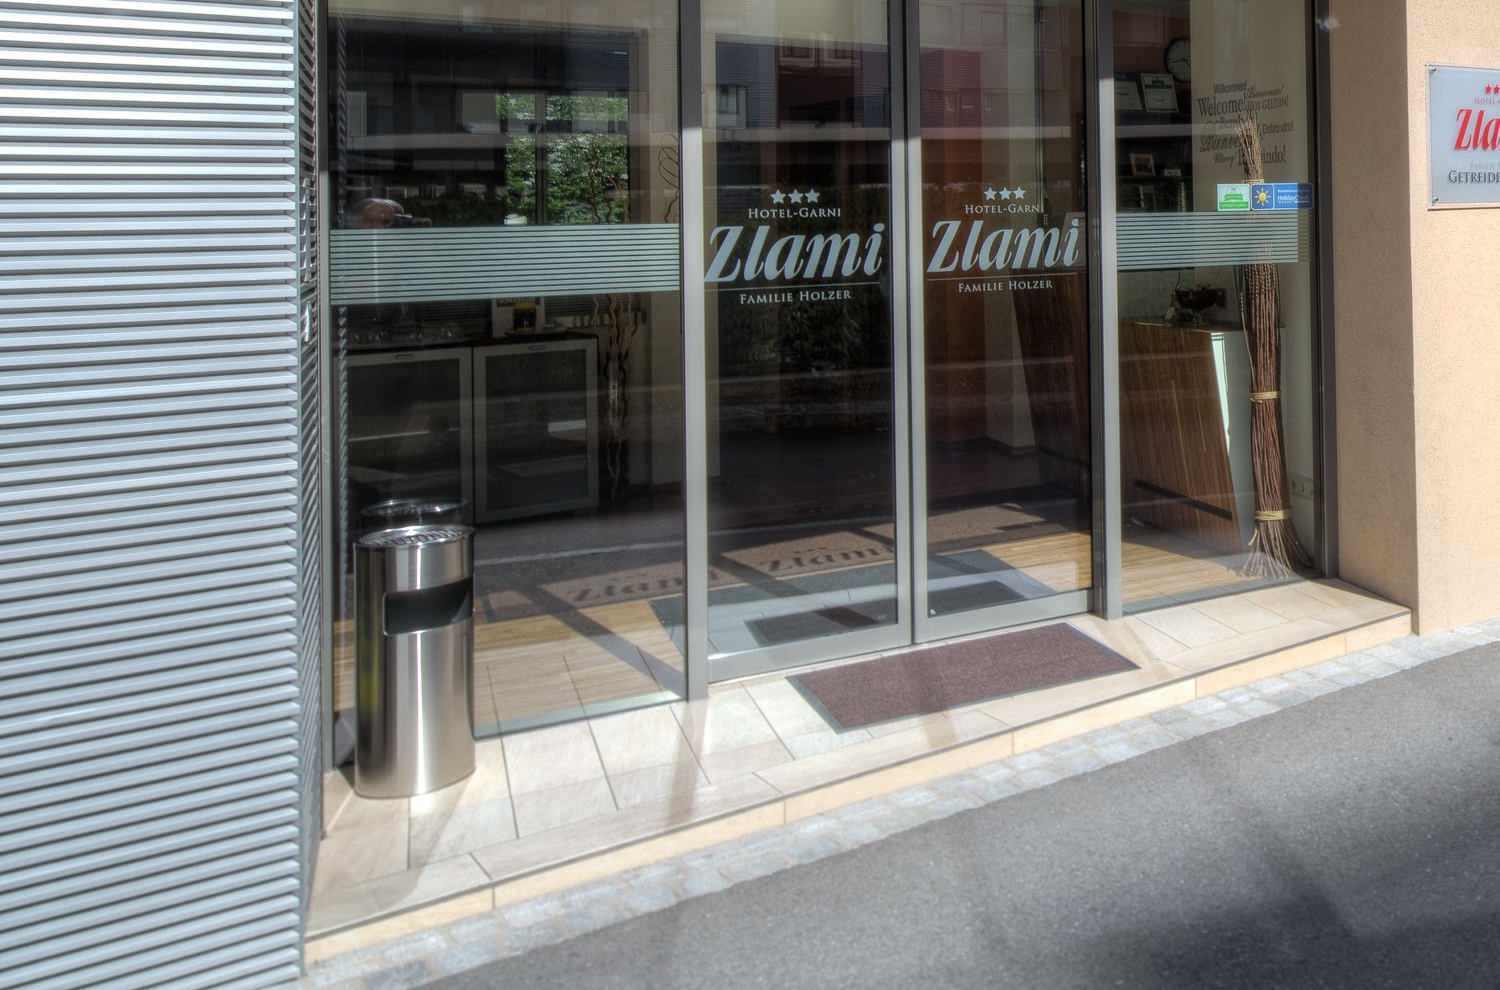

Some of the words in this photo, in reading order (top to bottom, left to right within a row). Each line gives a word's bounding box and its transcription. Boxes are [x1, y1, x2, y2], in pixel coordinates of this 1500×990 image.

[1198, 92, 1246, 117] Welcome!
[748, 207, 842, 219] HOTEL-GARNI
[964, 203, 1045, 215] HOTEL-GARNI
[704, 222, 886, 283] Zlami
[926, 218, 1080, 273] Zlami
[958, 281, 1005, 293] FAMILIE
[1008, 278, 1054, 291] HOLZER
[739, 292, 794, 305] FAMILIE
[799, 289, 852, 302] HOLZER
